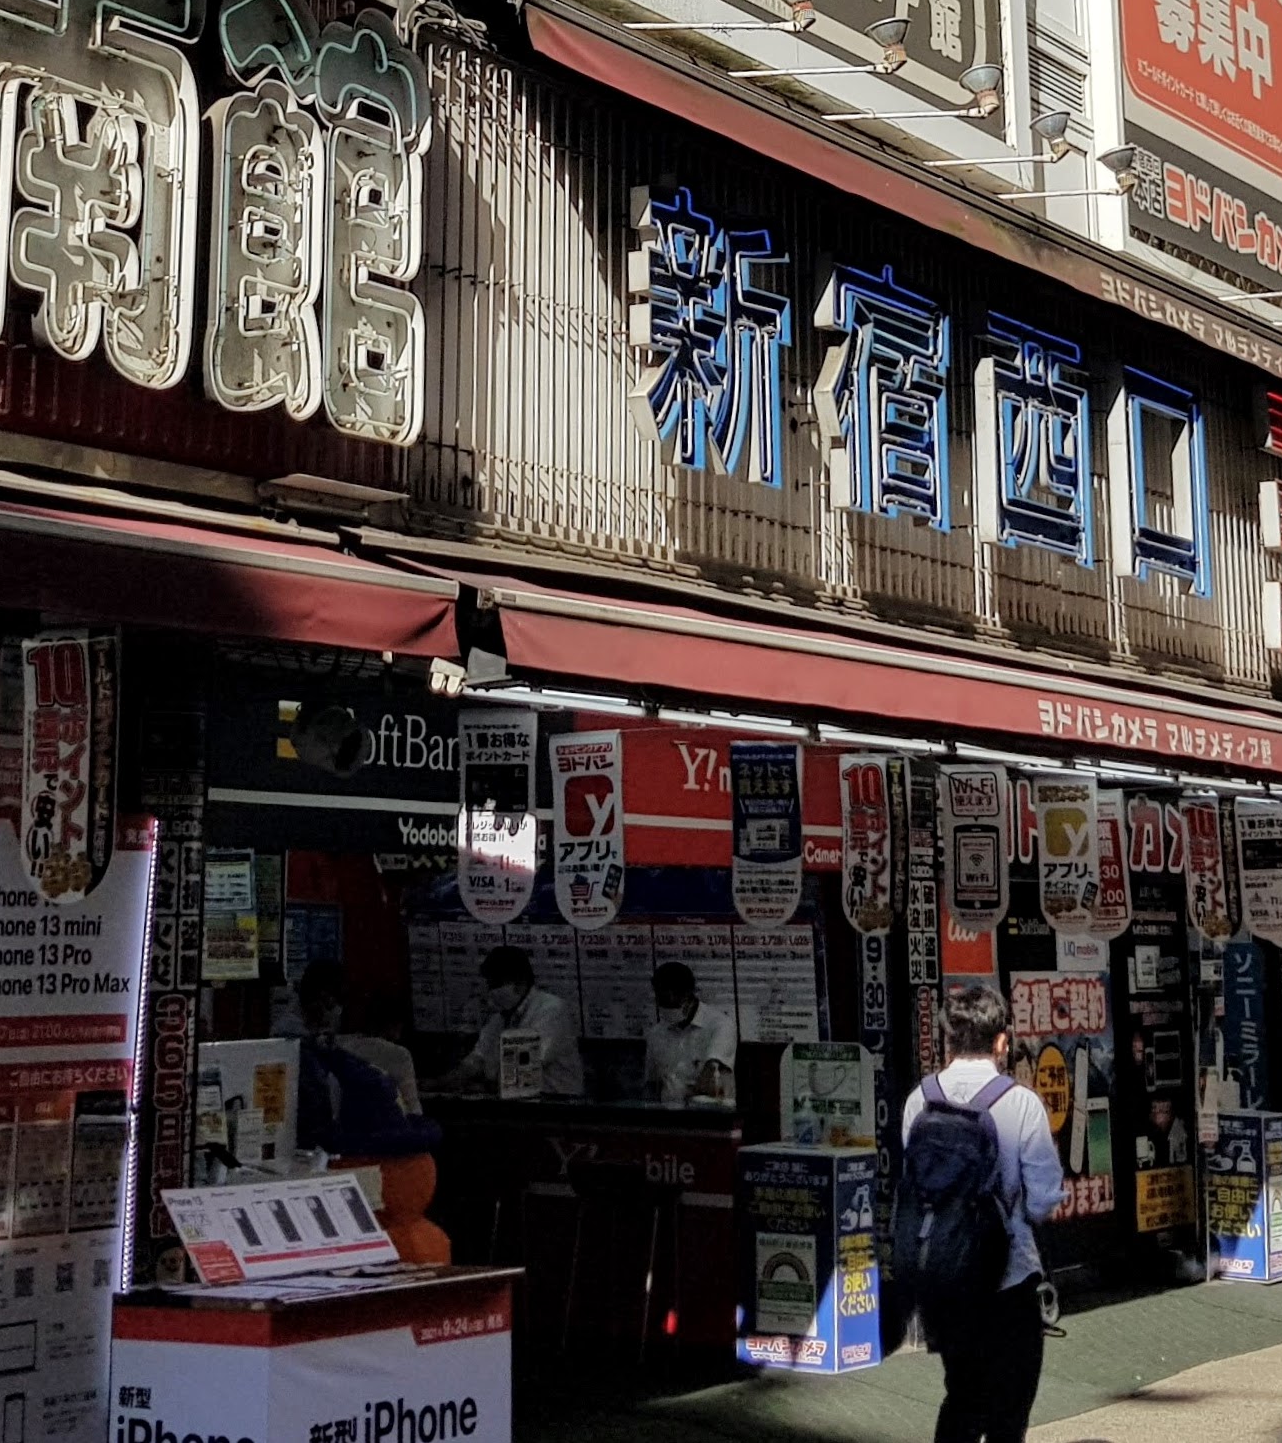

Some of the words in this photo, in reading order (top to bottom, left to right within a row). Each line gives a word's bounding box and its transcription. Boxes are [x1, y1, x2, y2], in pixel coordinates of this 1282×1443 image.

[1100, 271, 1206, 339] ヨドバシカメラ
[628, 187, 1212, 598] 新宿西口
[1037, 698, 1159, 747] ヨドバシカメラ
[558, 755, 614, 773] ヨドバシ
[843, 763, 883, 808] 10
[953, 777, 996, 795] Wi-Fi
[559, 840, 618, 863] アプリで
[468, 875, 497, 889] VISA
[964, 872, 990, 883] Wi-Fi
[1043, 862, 1095, 879] アプリで
[39, 914, 60, 936] 13
[64, 913, 102, 937] mini
[38, 944, 59, 967] 13
[61, 944, 92, 967] Pro
[37, 974, 59, 996] 13
[60, 973, 92, 995] Pro
[94, 972, 130, 995] Max
[839, 1294, 877, 1316] ください
[118, 1385, 153, 1409] 新型
[363, 1394, 479, 1443] iPhone
